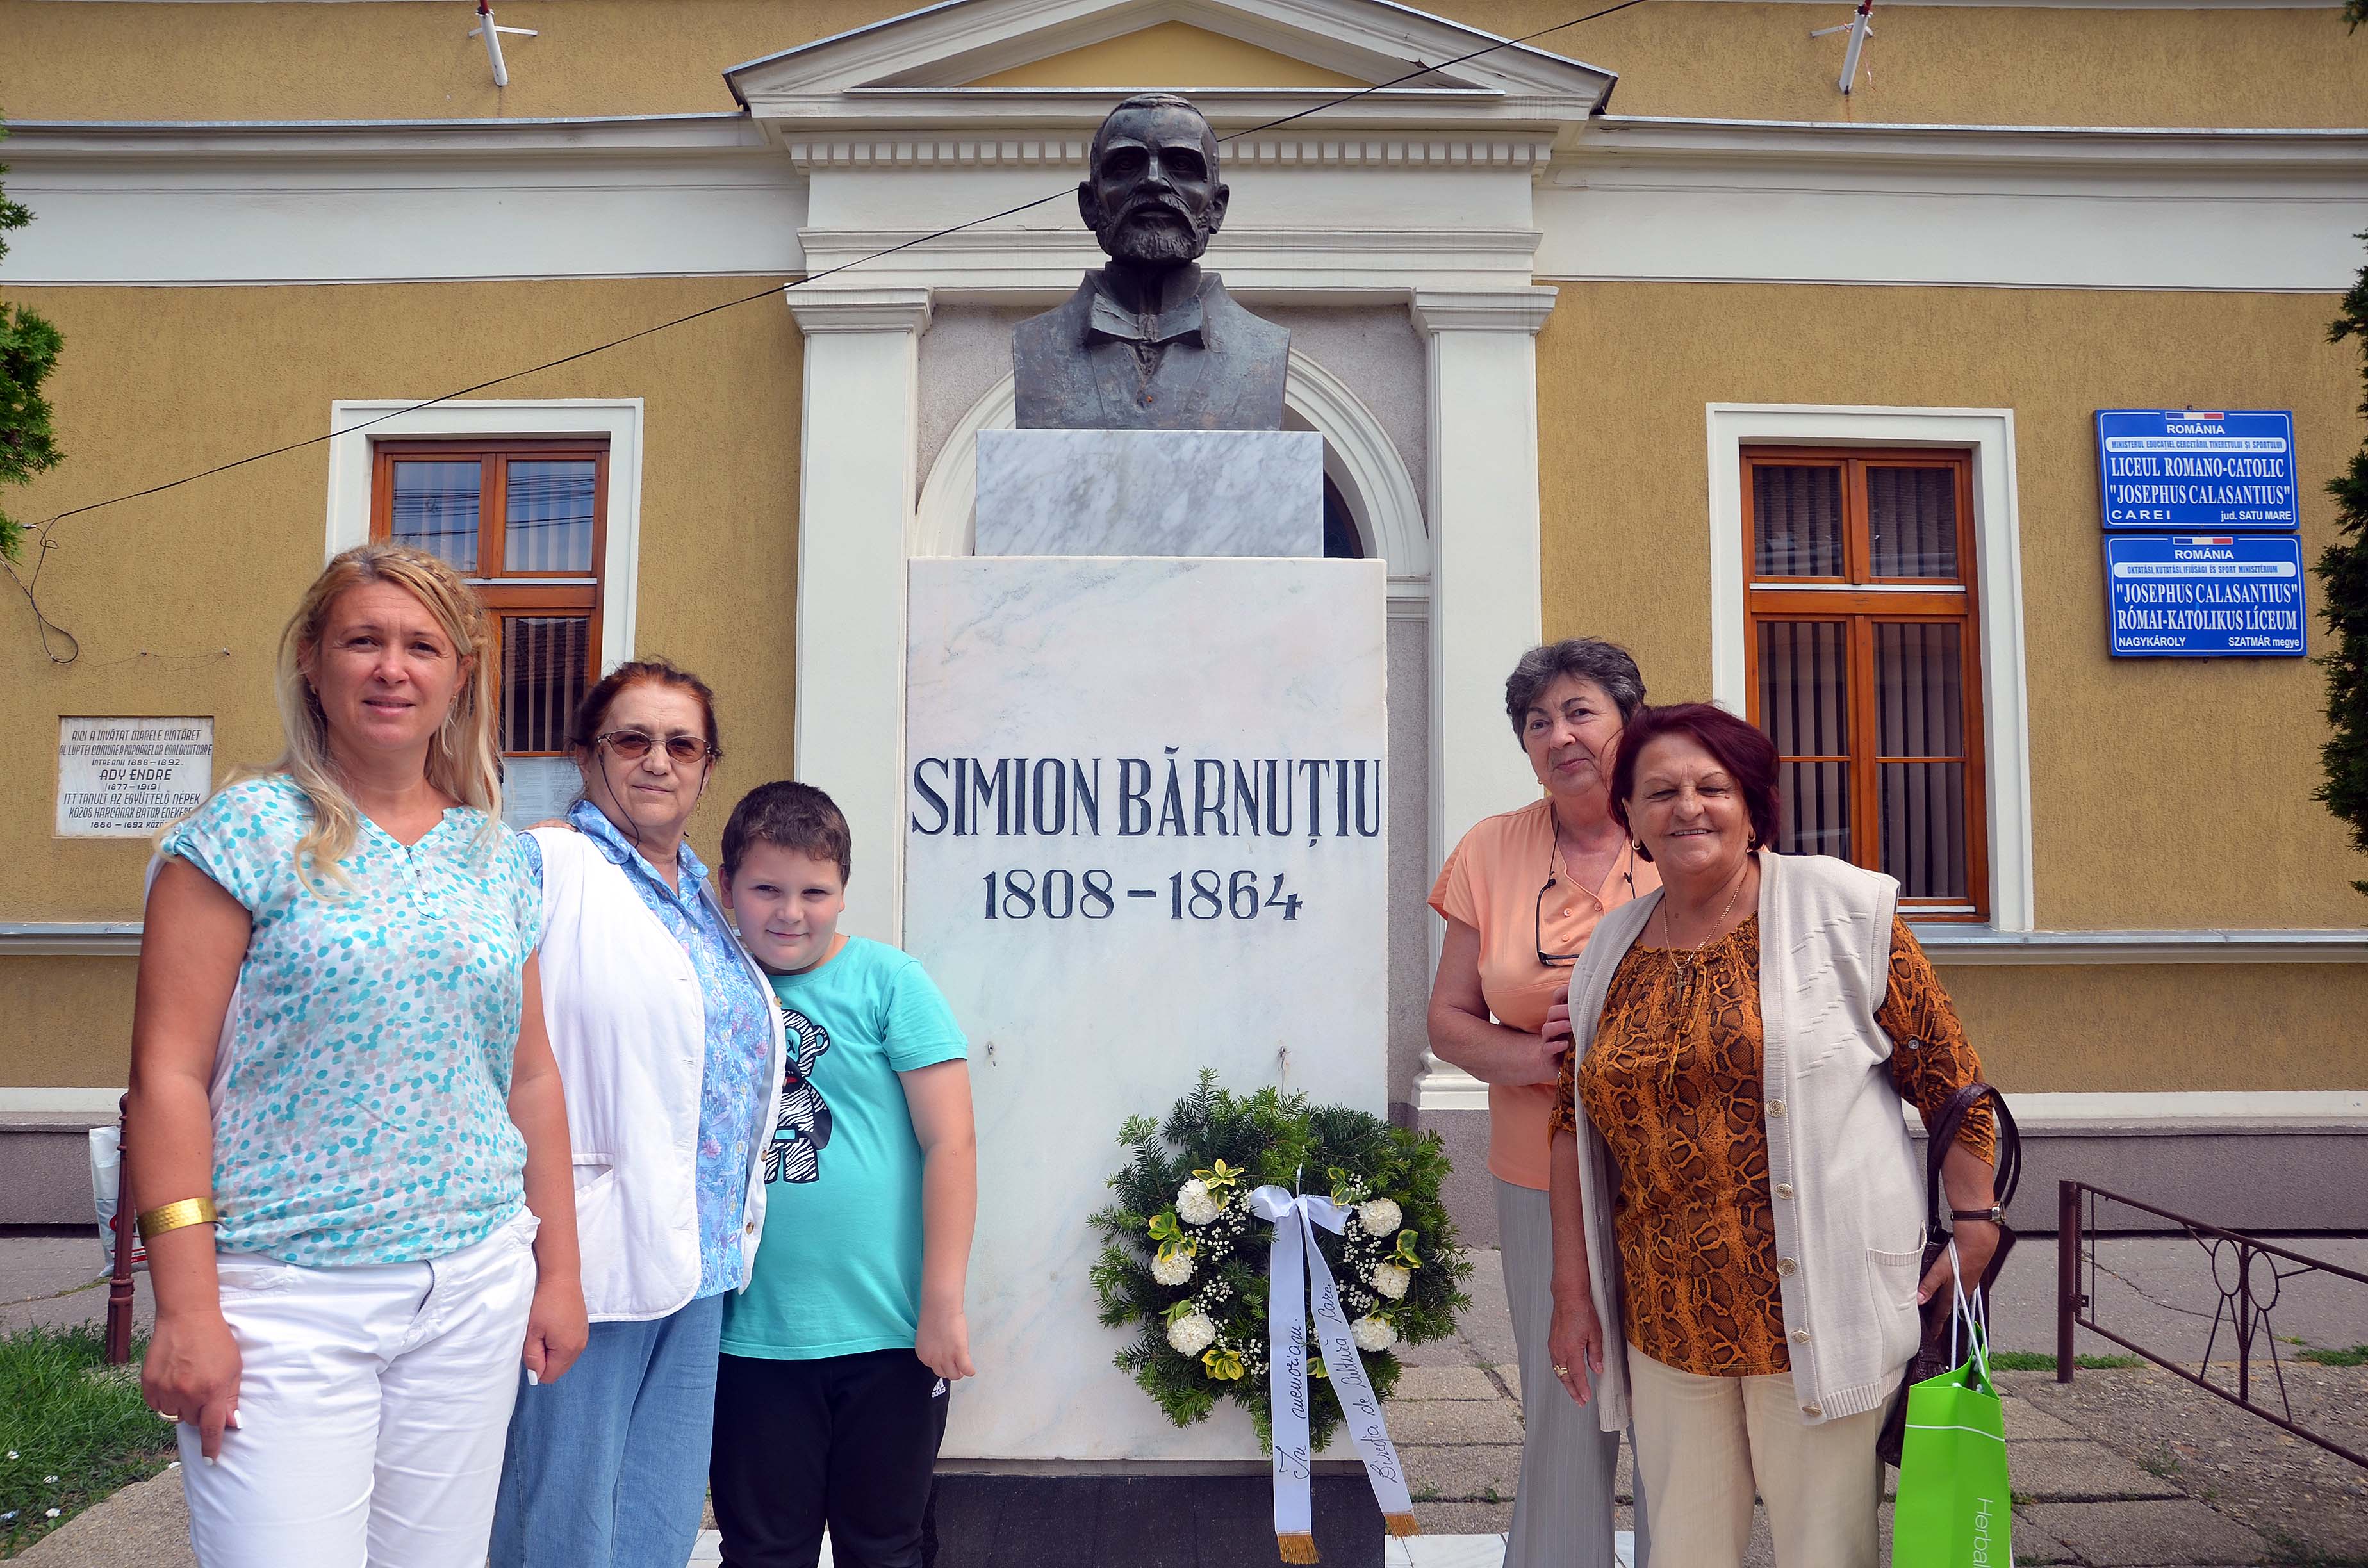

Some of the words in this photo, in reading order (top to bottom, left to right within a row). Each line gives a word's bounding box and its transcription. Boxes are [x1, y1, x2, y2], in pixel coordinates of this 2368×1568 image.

[2166, 423, 2225, 434] ROMÂNIA
[2111, 440, 2144, 448] MINISTERUL
[2210, 440, 2242, 449] TINERETULUI
[2253, 441, 2282, 449] SPORTULUI
[2110, 457, 2160, 477] LICEUL
[2164, 457, 2285, 478] ROMANO-CATOLIC
[2110, 484, 2187, 504] "JOSEPHUS
[2189, 484, 2290, 505] CALASANTIUS"
[2111, 510, 2171, 520] CAREI
[2221, 510, 2237, 522] jud.
[2239, 510, 2263, 520] SATU
[2265, 511, 2292, 521] MARE
[2174, 548, 2234, 559] ROMÁNIA
[2218, 565, 2236, 574] SPORT
[2116, 584, 2194, 603] "JOSEPHUS
[2195, 584, 2298, 603] CALASANTIUS"
[2117, 604, 2244, 630] RÓMAI-KATOLIKUS
[2245, 605, 2298, 630] LÍCEUM
[2119, 635, 2186, 647] NAGYKÁROLY
[2228, 635, 2271, 647] SZATMÁR
[2272, 639, 2300, 649] megye
[71, 730, 88, 741] AICI
[89, 730, 96, 741] A
[131, 730, 163, 741] MARELE
[59, 744, 66, 756] AL
[68, 744, 90, 756] LUPTEI
[91, 744, 120, 756] COMUNE
[119, 744, 124, 756] A
[124, 744, 163, 756] POPOARELOR
[99, 769, 127, 780] ADY
[129, 769, 172, 780] ENDRE
[63, 793, 78, 804] ITT
[79, 793, 109, 804] TANULT
[110, 793, 122, 804] AZ
[172, 790, 201, 804] NÉPEK
[912, 756, 1100, 837] SIMION
[1117, 746, 1381, 848] BĂRNUȚIU
[69, 805, 93, 819] KÖZÖS
[94, 804, 135, 819] HARCÁNAK
[135, 804, 160, 819] BÁTOR
[1353, 1396, 1376, 1416] de
